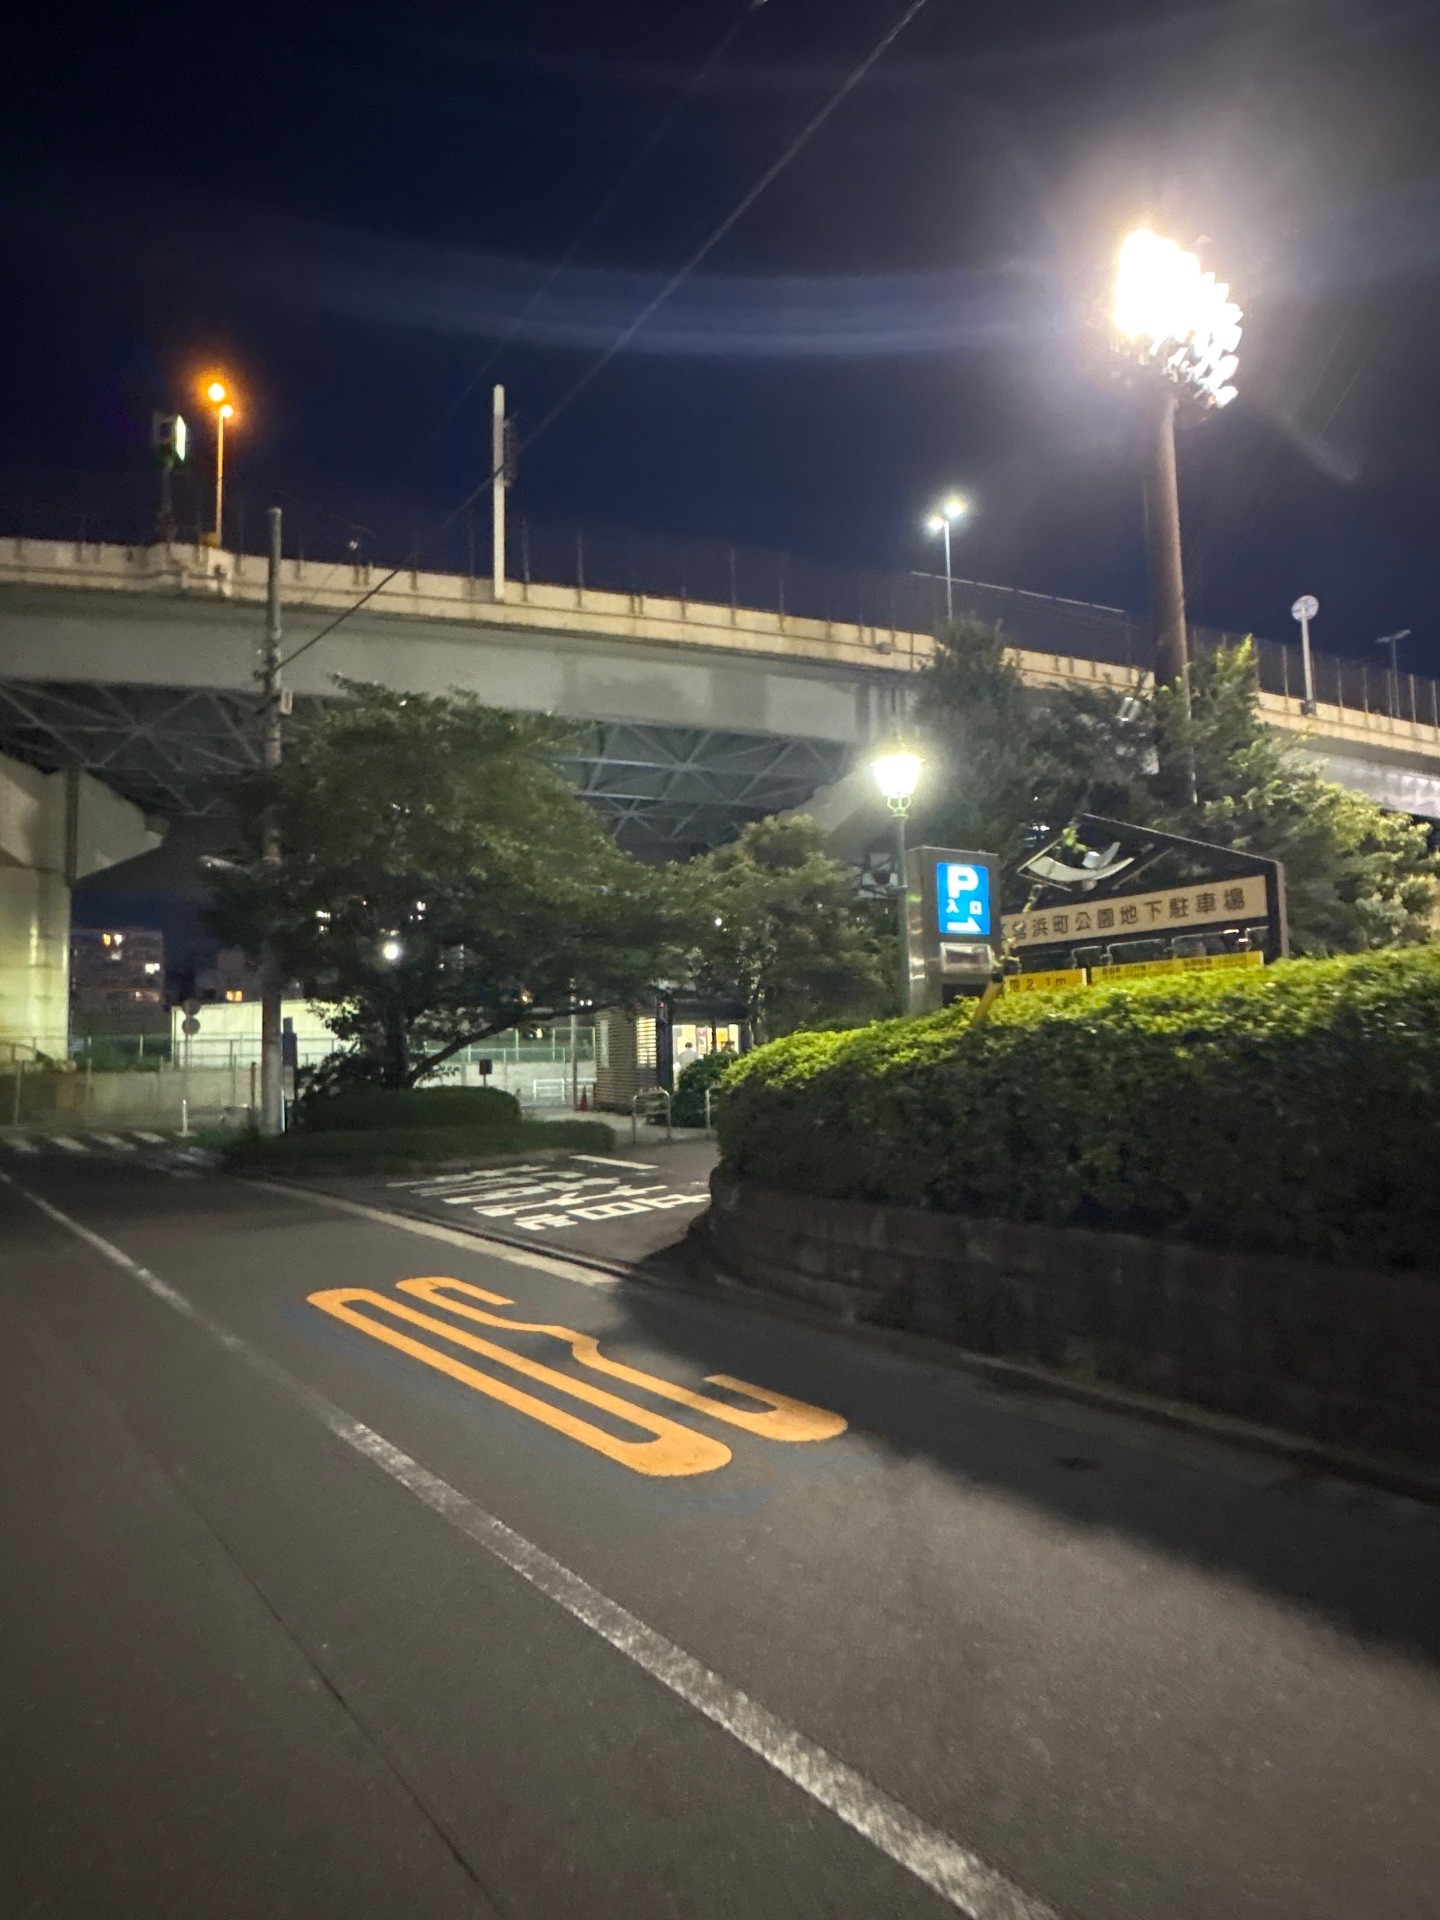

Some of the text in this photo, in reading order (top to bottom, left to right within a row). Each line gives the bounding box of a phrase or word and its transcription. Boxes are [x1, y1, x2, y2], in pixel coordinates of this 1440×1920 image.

[947, 865, 979, 898] P
[946, 898, 982, 915] 入口
[306, 1276, 848, 1477] 30
